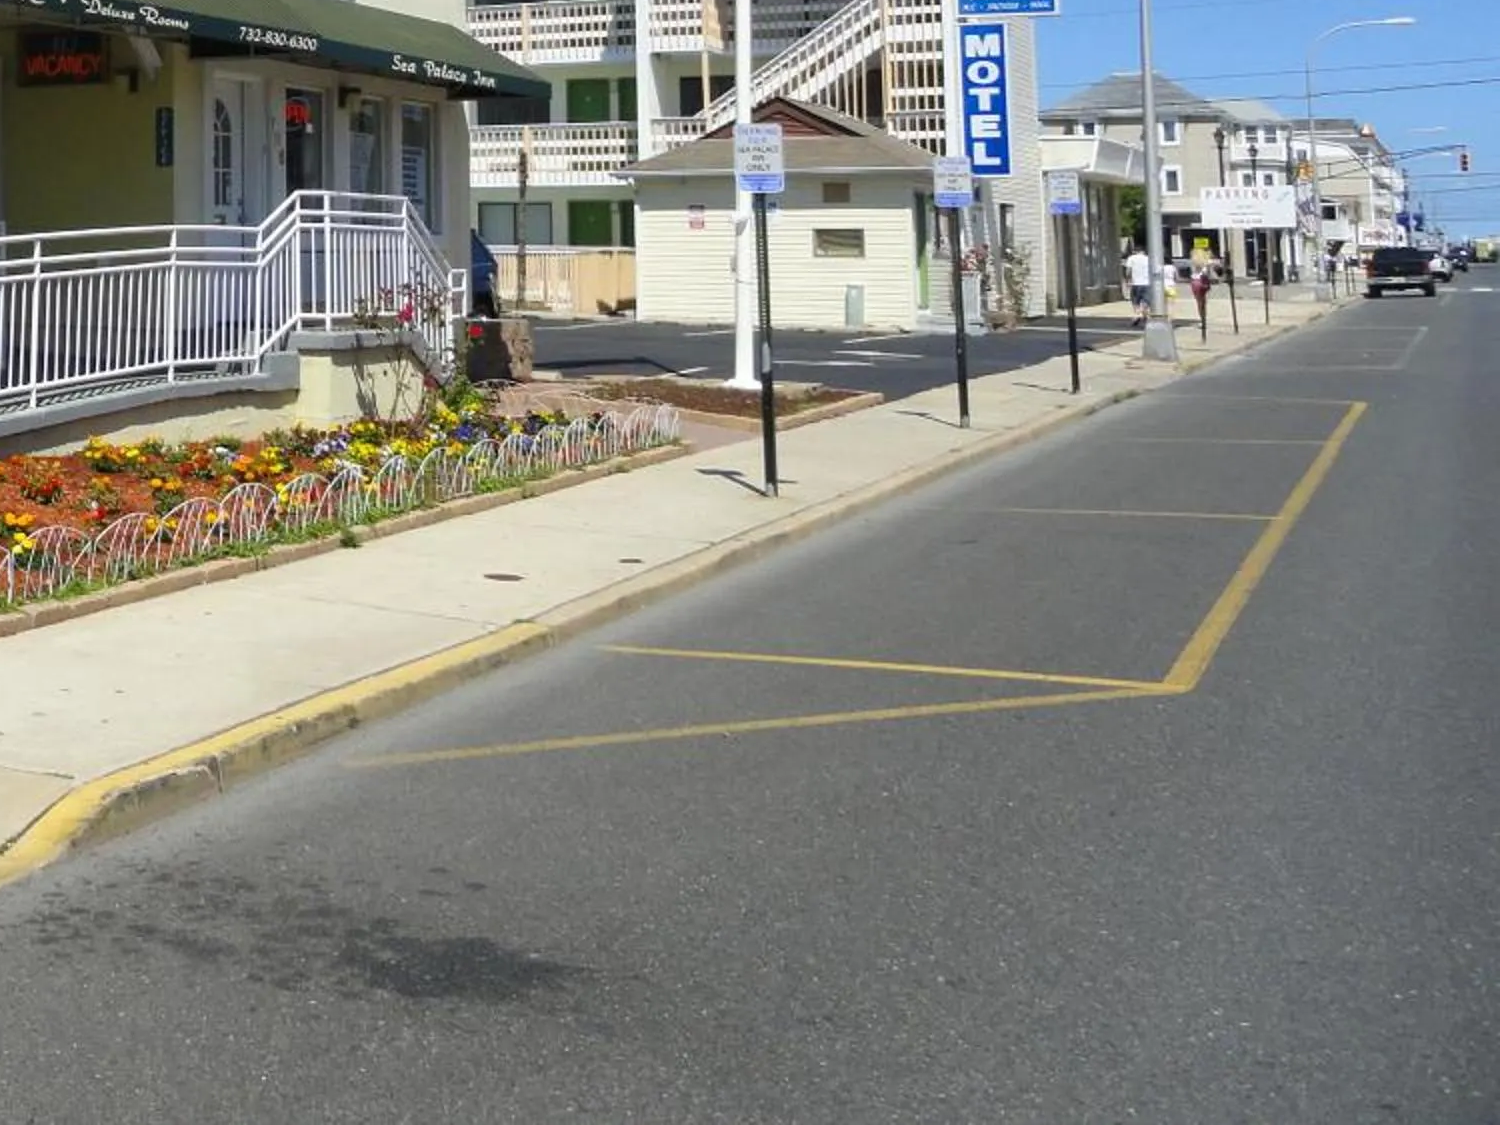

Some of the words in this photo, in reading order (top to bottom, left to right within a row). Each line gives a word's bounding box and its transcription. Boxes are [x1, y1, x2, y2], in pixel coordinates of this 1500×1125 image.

[139, 6, 191, 31] Rooms
[238, 26, 318, 52] 732-830-6300
[24, 53, 102, 77] VACANCY
[391, 55, 417, 74] Sea
[423, 61, 467, 84] Palace
[472, 70, 496, 89] Inn
[963, 32, 1003, 167] MOTEL
[1204, 188, 1270, 201] PARKING
